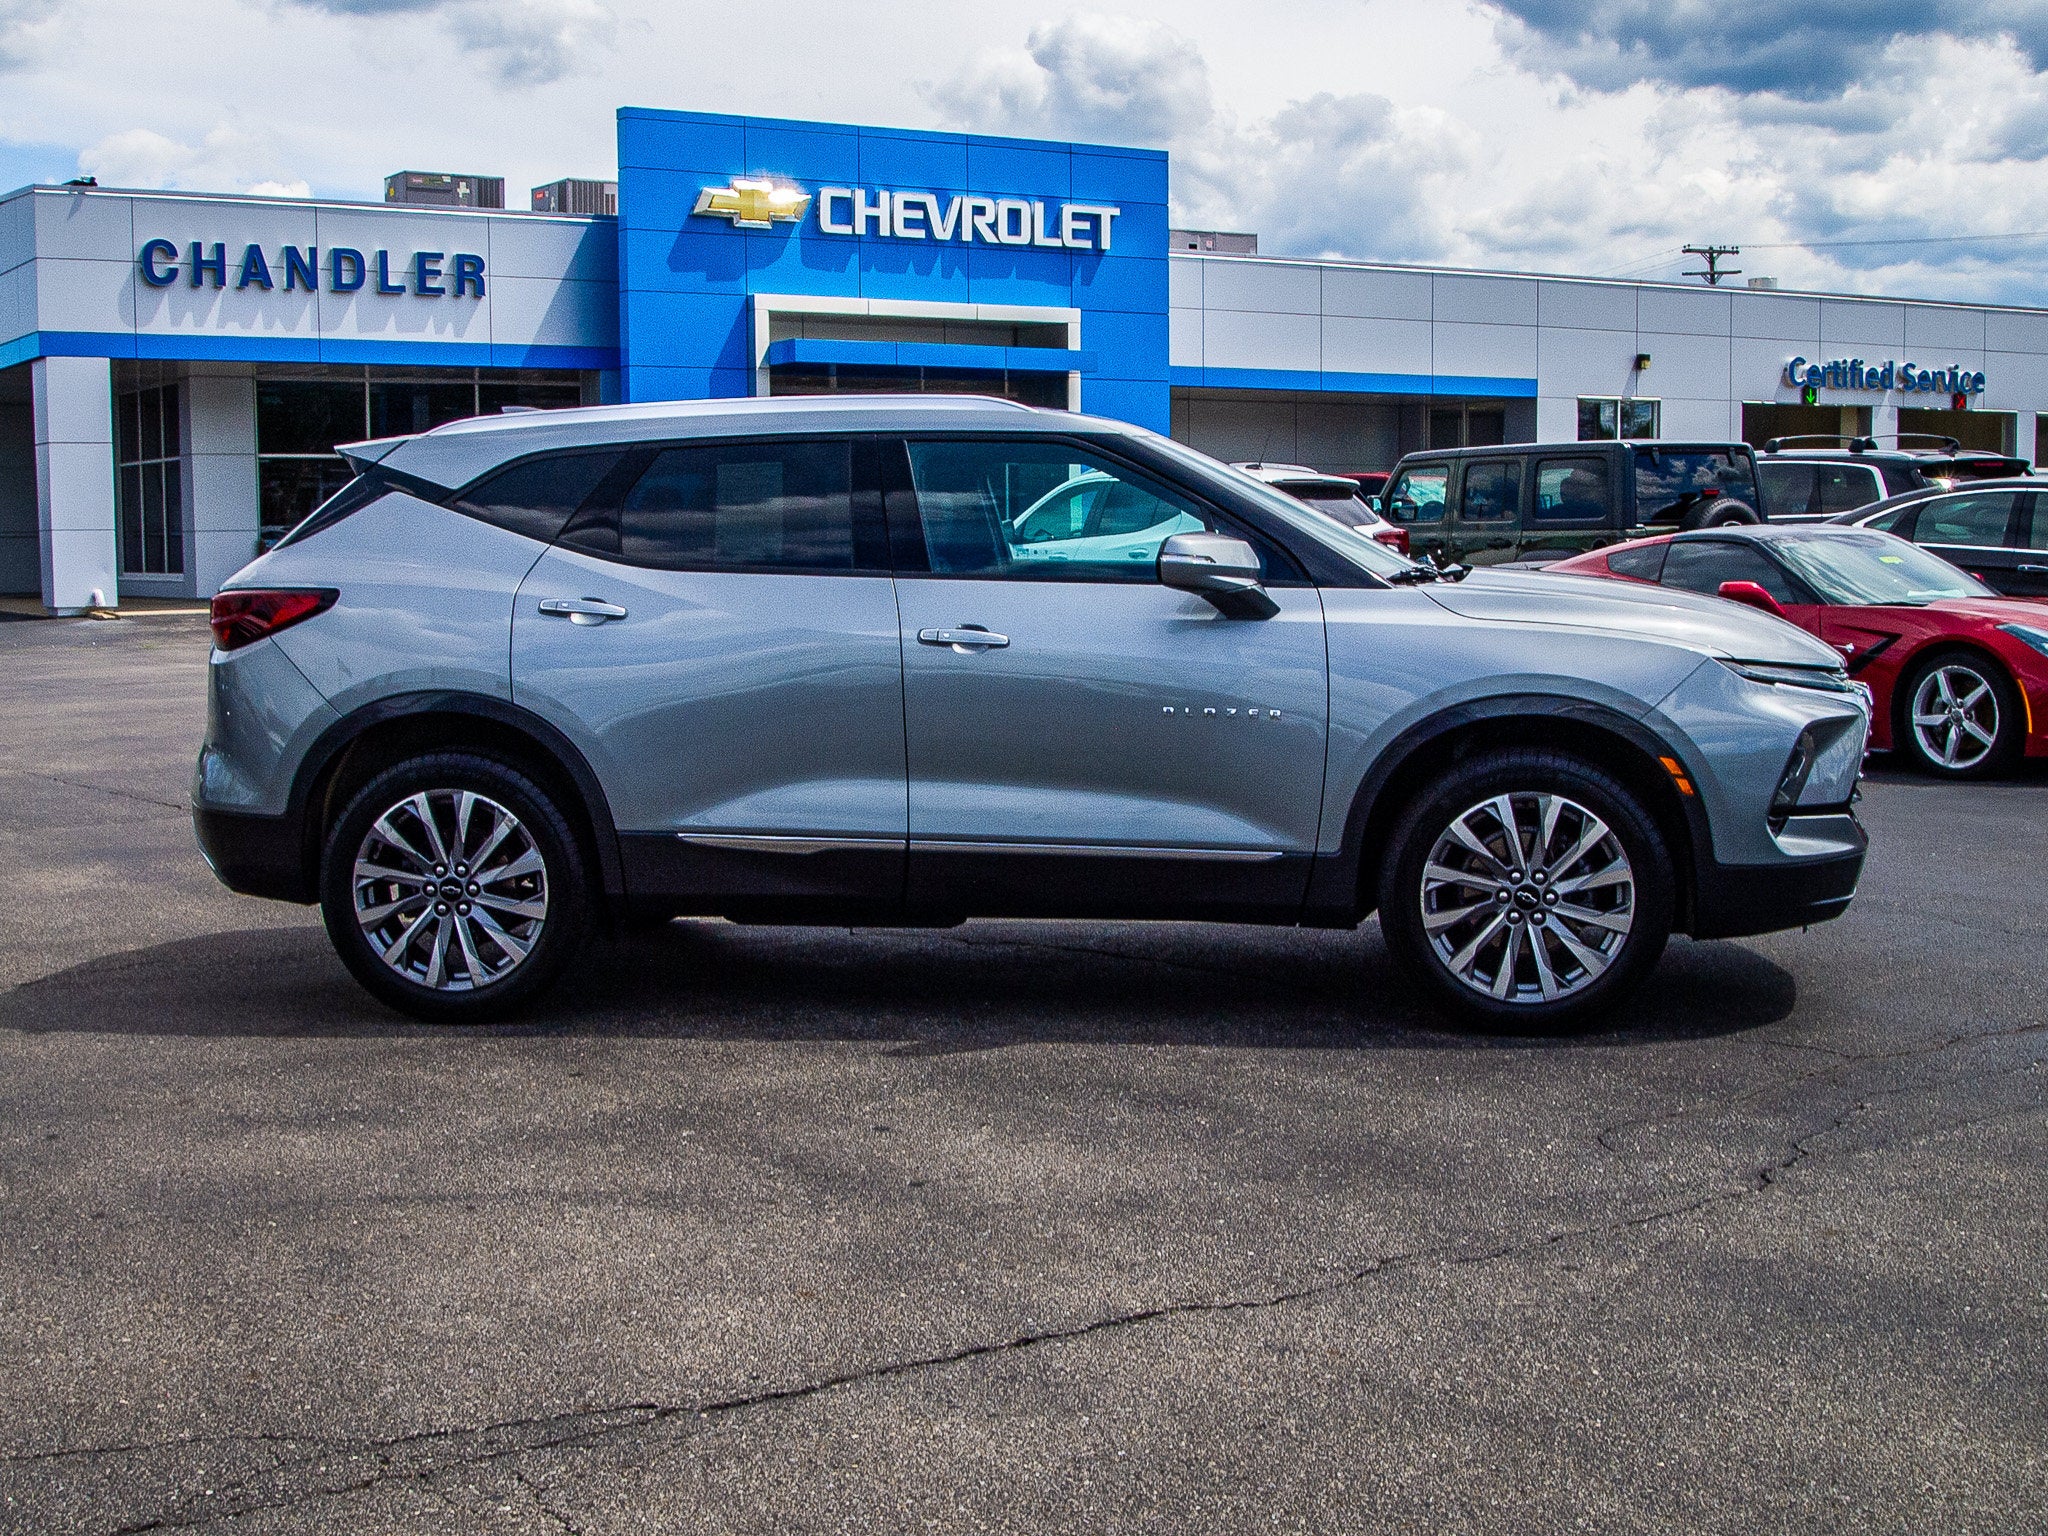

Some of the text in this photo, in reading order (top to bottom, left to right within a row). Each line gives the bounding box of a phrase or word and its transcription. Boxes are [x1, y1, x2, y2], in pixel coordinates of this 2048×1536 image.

[818, 186, 1121, 250] CHEVROLET
[140, 238, 487, 298] CHANDLER
[1788, 356, 1986, 395] Certified Service
